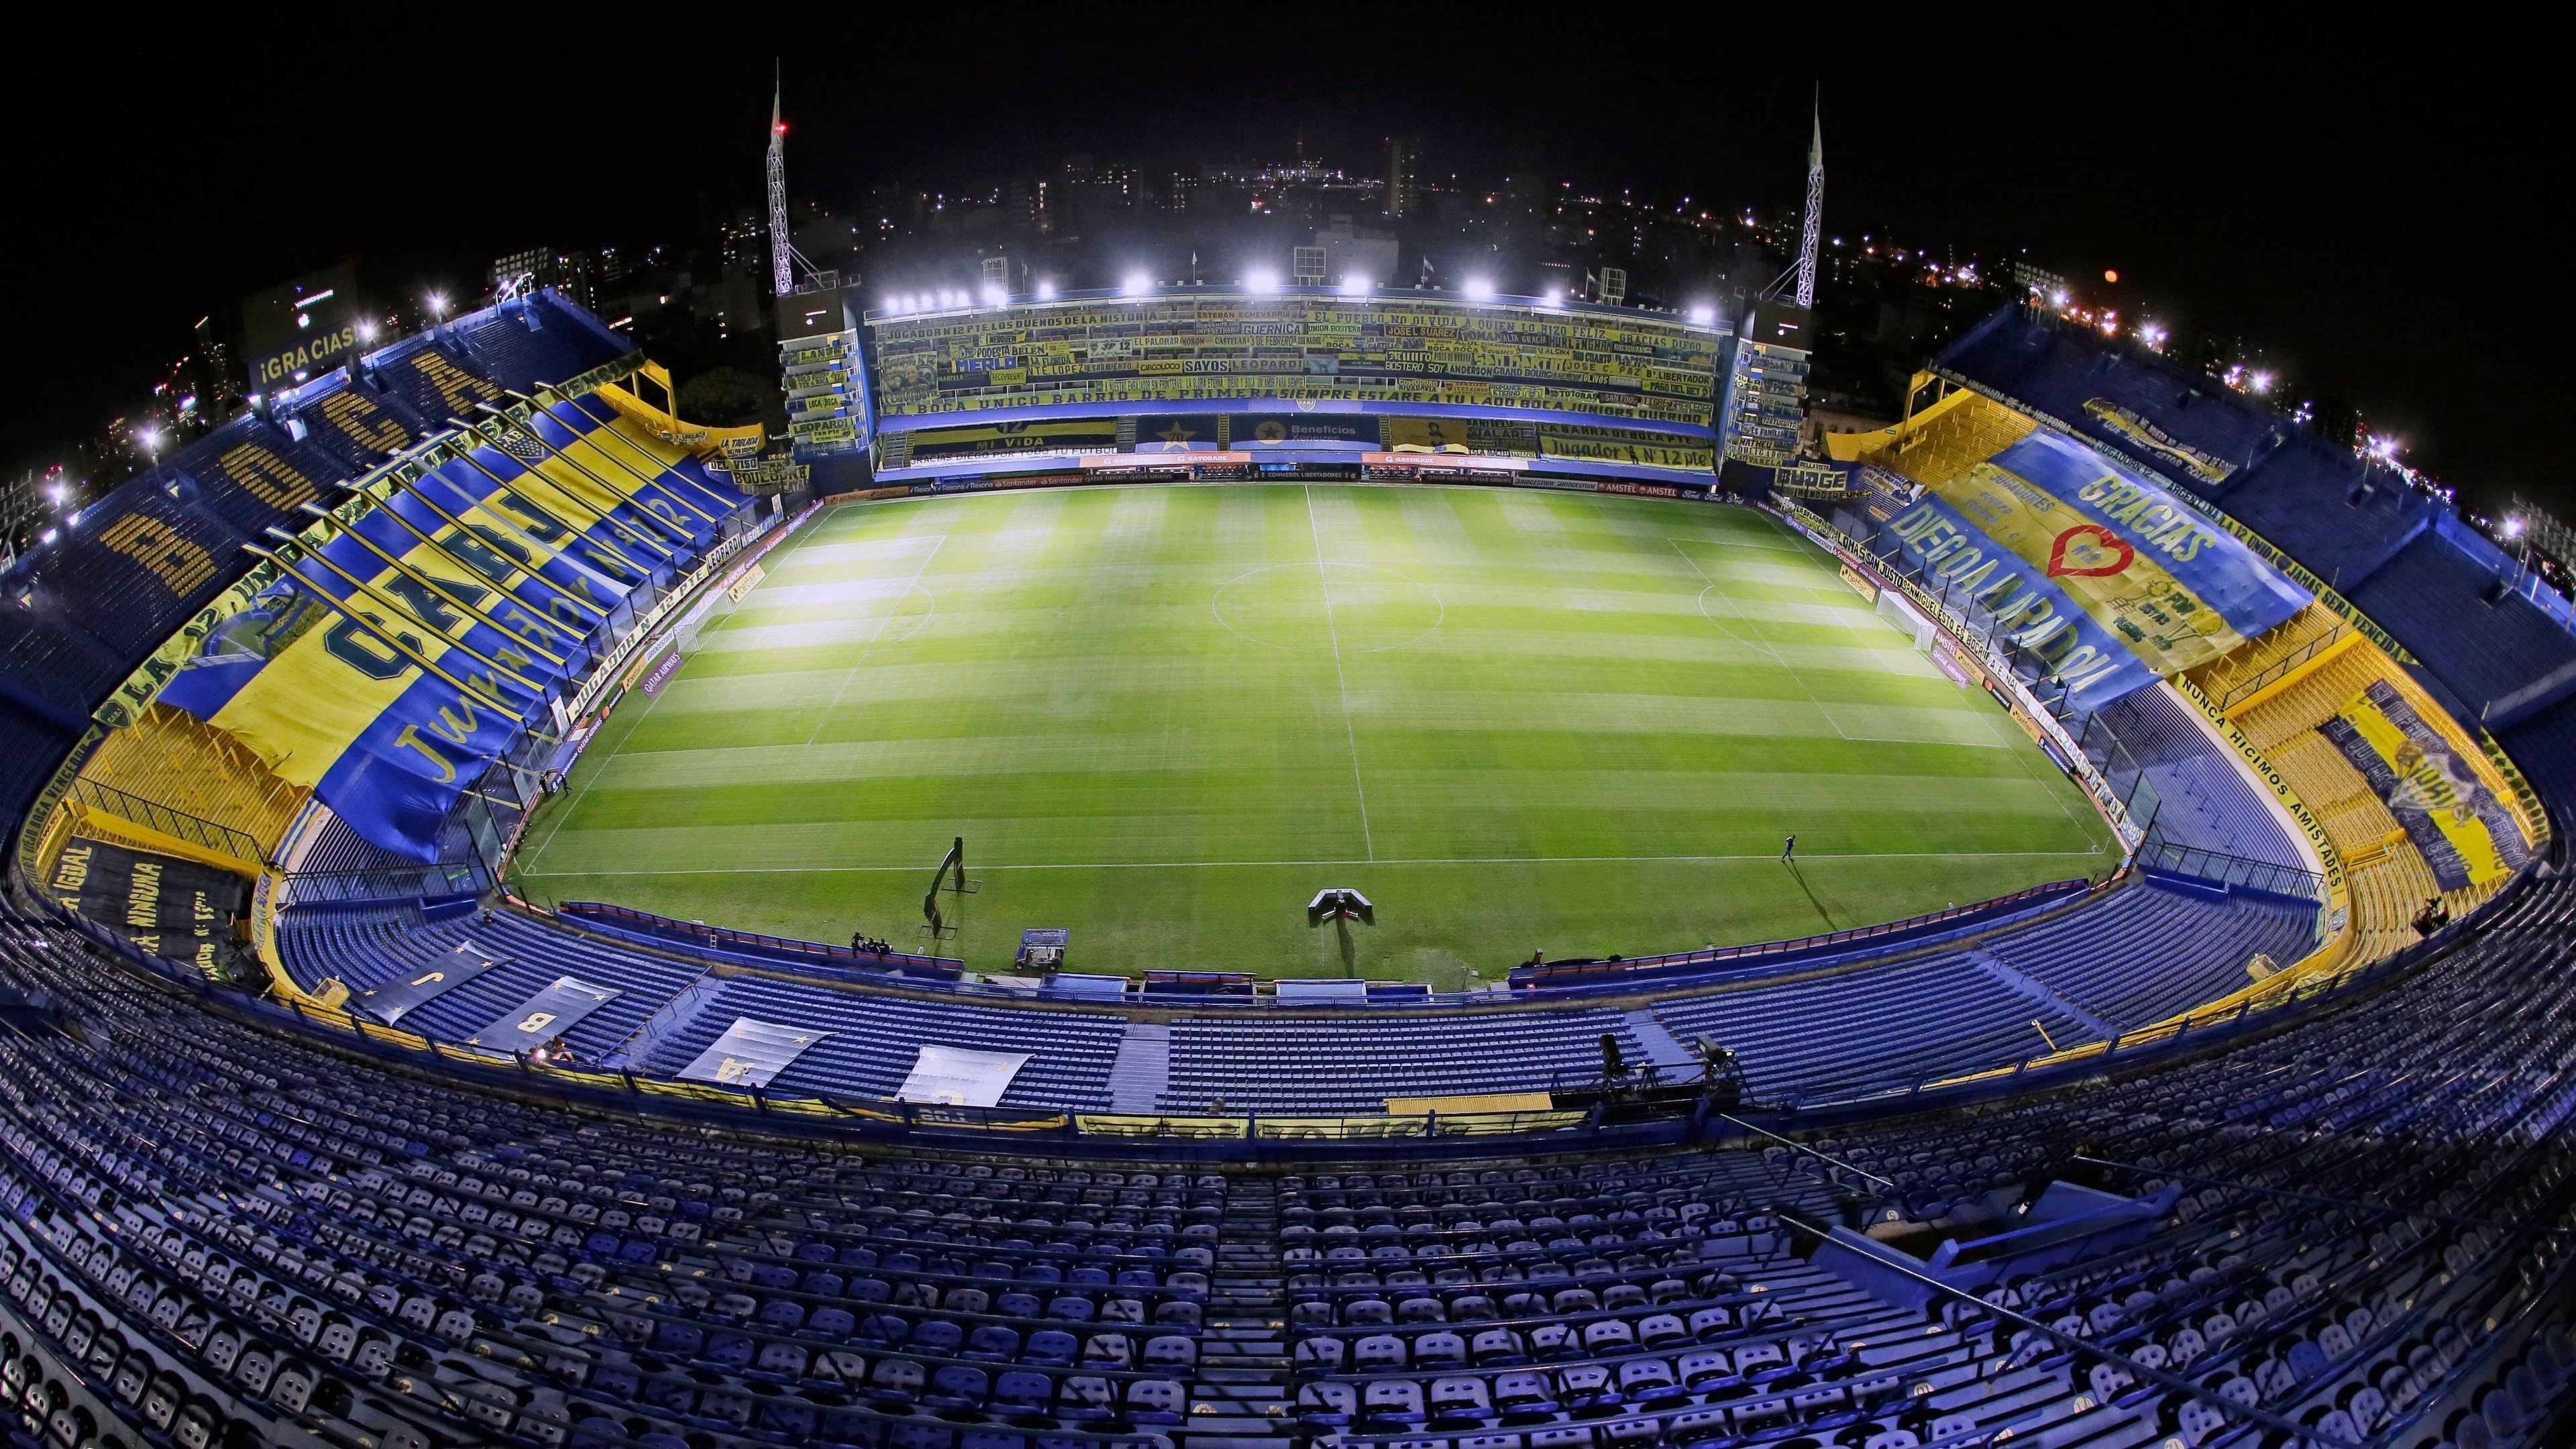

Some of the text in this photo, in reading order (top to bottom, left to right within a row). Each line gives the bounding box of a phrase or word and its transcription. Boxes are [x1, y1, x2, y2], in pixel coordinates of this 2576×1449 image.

[887, 312, 1157, 339] JUGADOR DE LA HISTORIA
[1244, 325, 1300, 335] GUERNICA
[1315, 312, 1702, 350] EL PUEBLO NO OLVIDA A QUIEN LO FELIZ GRACIAS DIEGO
[1421, 328, 1455, 336] SUAREZ
[1120, 341, 1130, 350] 12
[1145, 337, 1179, 345] PALOMAR
[1181, 337, 1204, 345] MORON
[1215, 337, 1246, 345] CASTELAR
[1256, 335, 1293, 346] DE FEBRERO
[1522, 335, 1546, 343] GRACIA
[977, 345, 1010, 357] PODESTA
[1012, 345, 1044, 356] BELEN
[957, 357, 1016, 371] MERLO
[1053, 364, 1083, 374] LOPEZ
[1140, 363, 1180, 371] CIRCOLOCO
[1185, 360, 1227, 372] SAYOS
[1233, 360, 1302, 368] LEOPARDI
[1386, 362, 1446, 373] BOSTERO SOY
[1450, 365, 1492, 376] ANDERSON
[1567, 362, 1640, 376] JOSE PAZ
[939, 374, 963, 382] MARCELO
[1494, 368, 1522, 376] GRAND
[1650, 382, 1701, 396] PASO DEL REY
[808, 397, 838, 409] LOCA BOCA
[882, 389, 1277, 415] LA BOCA UNICO BARRIO DE PRIMERA
[1279, 388, 1701, 423] SIEMPRE ESTARE A TU BOCA JUNIORS QUERIDO
[793, 419, 848, 434] LEOPARDI
[2034, 407, 2072, 433] HISTORIA
[1169, 433, 1184, 443] 70
[1291, 425, 1356, 443] Beneficios Xeneizes
[976, 437, 1044, 450] MI VIDA
[911, 454, 951, 465] GRACIAS
[956, 450, 989, 460] DIEGO
[1020, 447, 1049, 455] TODO
[1550, 439, 1621, 457] Jugador
[1661, 449, 1681, 465] 12
[1684, 451, 1706, 467] pte
[735, 459, 756, 468] VISO
[1002, 479, 1036, 487] Santander
[1515, 478, 1554, 486] BRIDGESTONE
[1557, 481, 1596, 489] BRIDGESTONE
[1778, 470, 1845, 488] BUDGE
[1606, 484, 1637, 493] AMSTEL
[1646, 486, 1676, 497] AMSTEL
[1682, 490, 1700, 499] Ford
[1839, 490, 1872, 498] FUNES
[1705, 492, 1723, 502] Ford
[2078, 475, 2216, 563] GRACIAS
[769, 531, 787, 548] Santander
[1838, 533, 1866, 559] LOMAS
[706, 535, 741, 569] LEOPARDI
[1836, 550, 1858, 570] Santander
[727, 564, 747, 586] AMSTEL
[1866, 551, 1902, 588] SAN JUSTO
[325, 494, 574, 680] CABJ
[2246, 535, 2402, 660] UNIDA JAMAS SERA VENCIDA
[1938, 610, 1965, 640] ESTO ES
[1935, 632, 1957, 656] AMSTEL
[574, 596, 675, 712] JUGADOR 12
[644, 651, 681, 692] QATAR AIRWAYS
[1933, 649, 1966, 685] QATAR AIRWAYS
[578, 718, 602, 753] QATAR AIRWAYS
[2182, 678, 2343, 889] NUNCA HICIMOS AMISTADES
[23, 743, 87, 853] VENCEDOR BOCA VIEJO
[53, 846, 93, 892] IGUAL
[127, 862, 162, 928] NINGUNA
